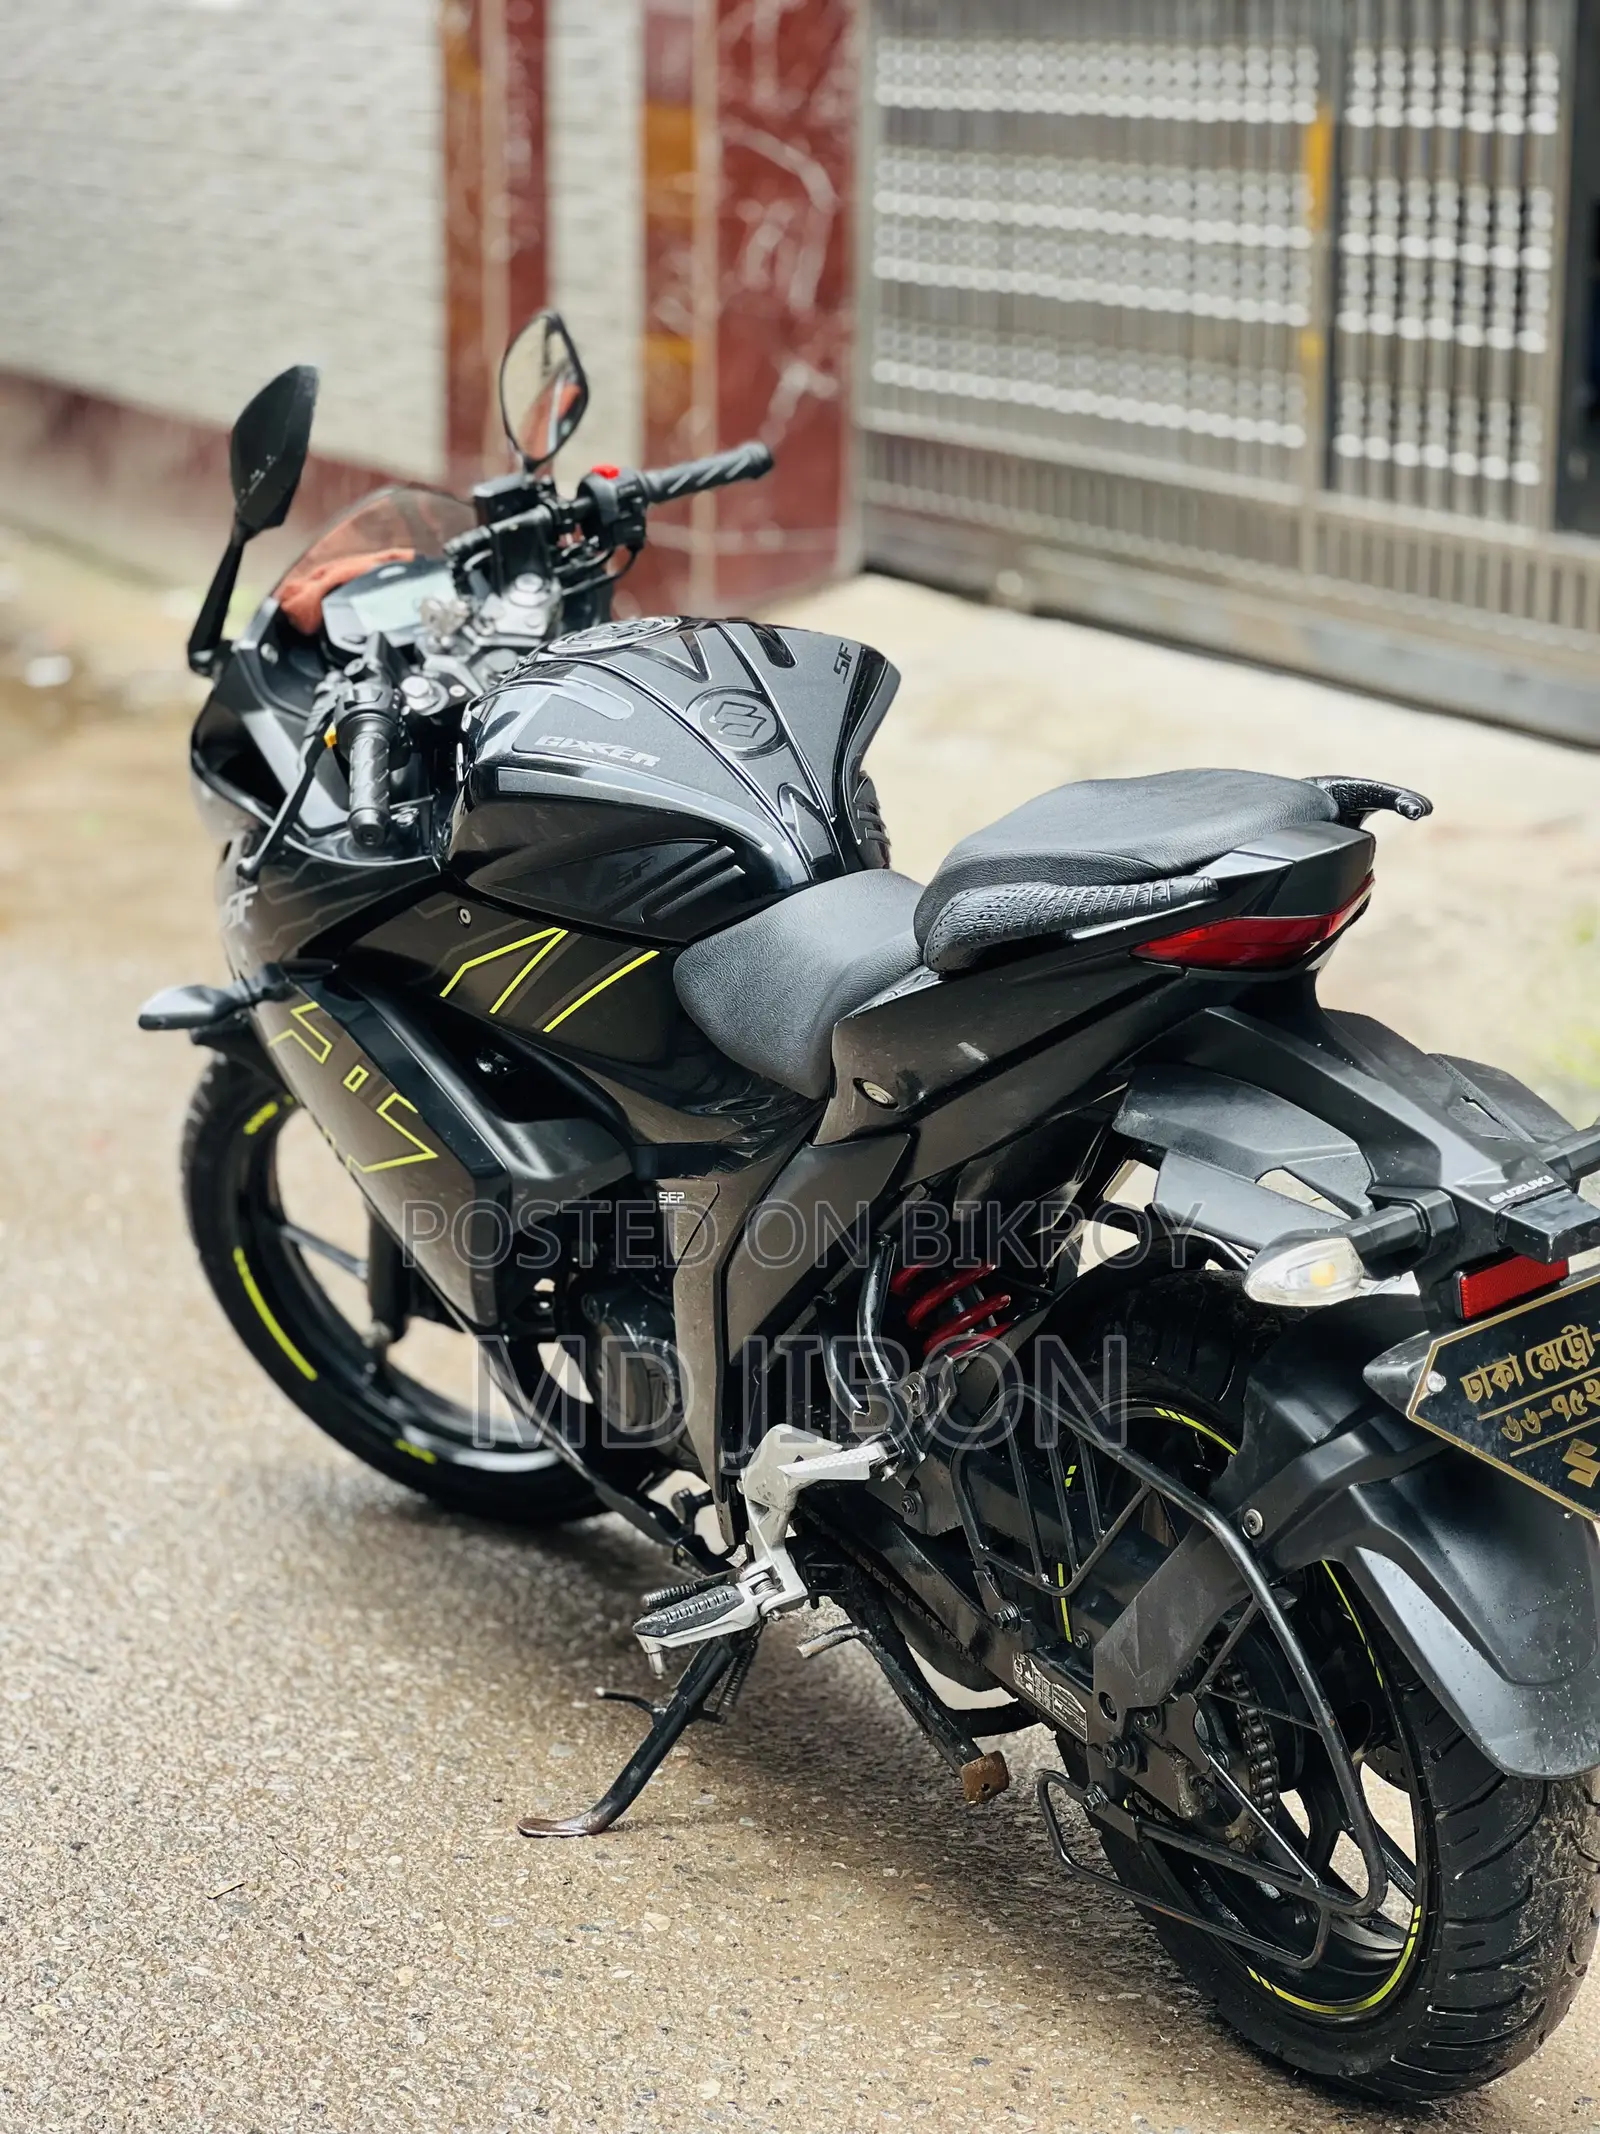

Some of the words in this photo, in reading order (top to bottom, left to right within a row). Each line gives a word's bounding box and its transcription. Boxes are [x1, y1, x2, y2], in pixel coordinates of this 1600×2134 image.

[534, 735, 661, 767] GIXXER
[1488, 1175, 1555, 1204] SUZUKI
[1460, 1352, 1525, 1403] ঢাকা
